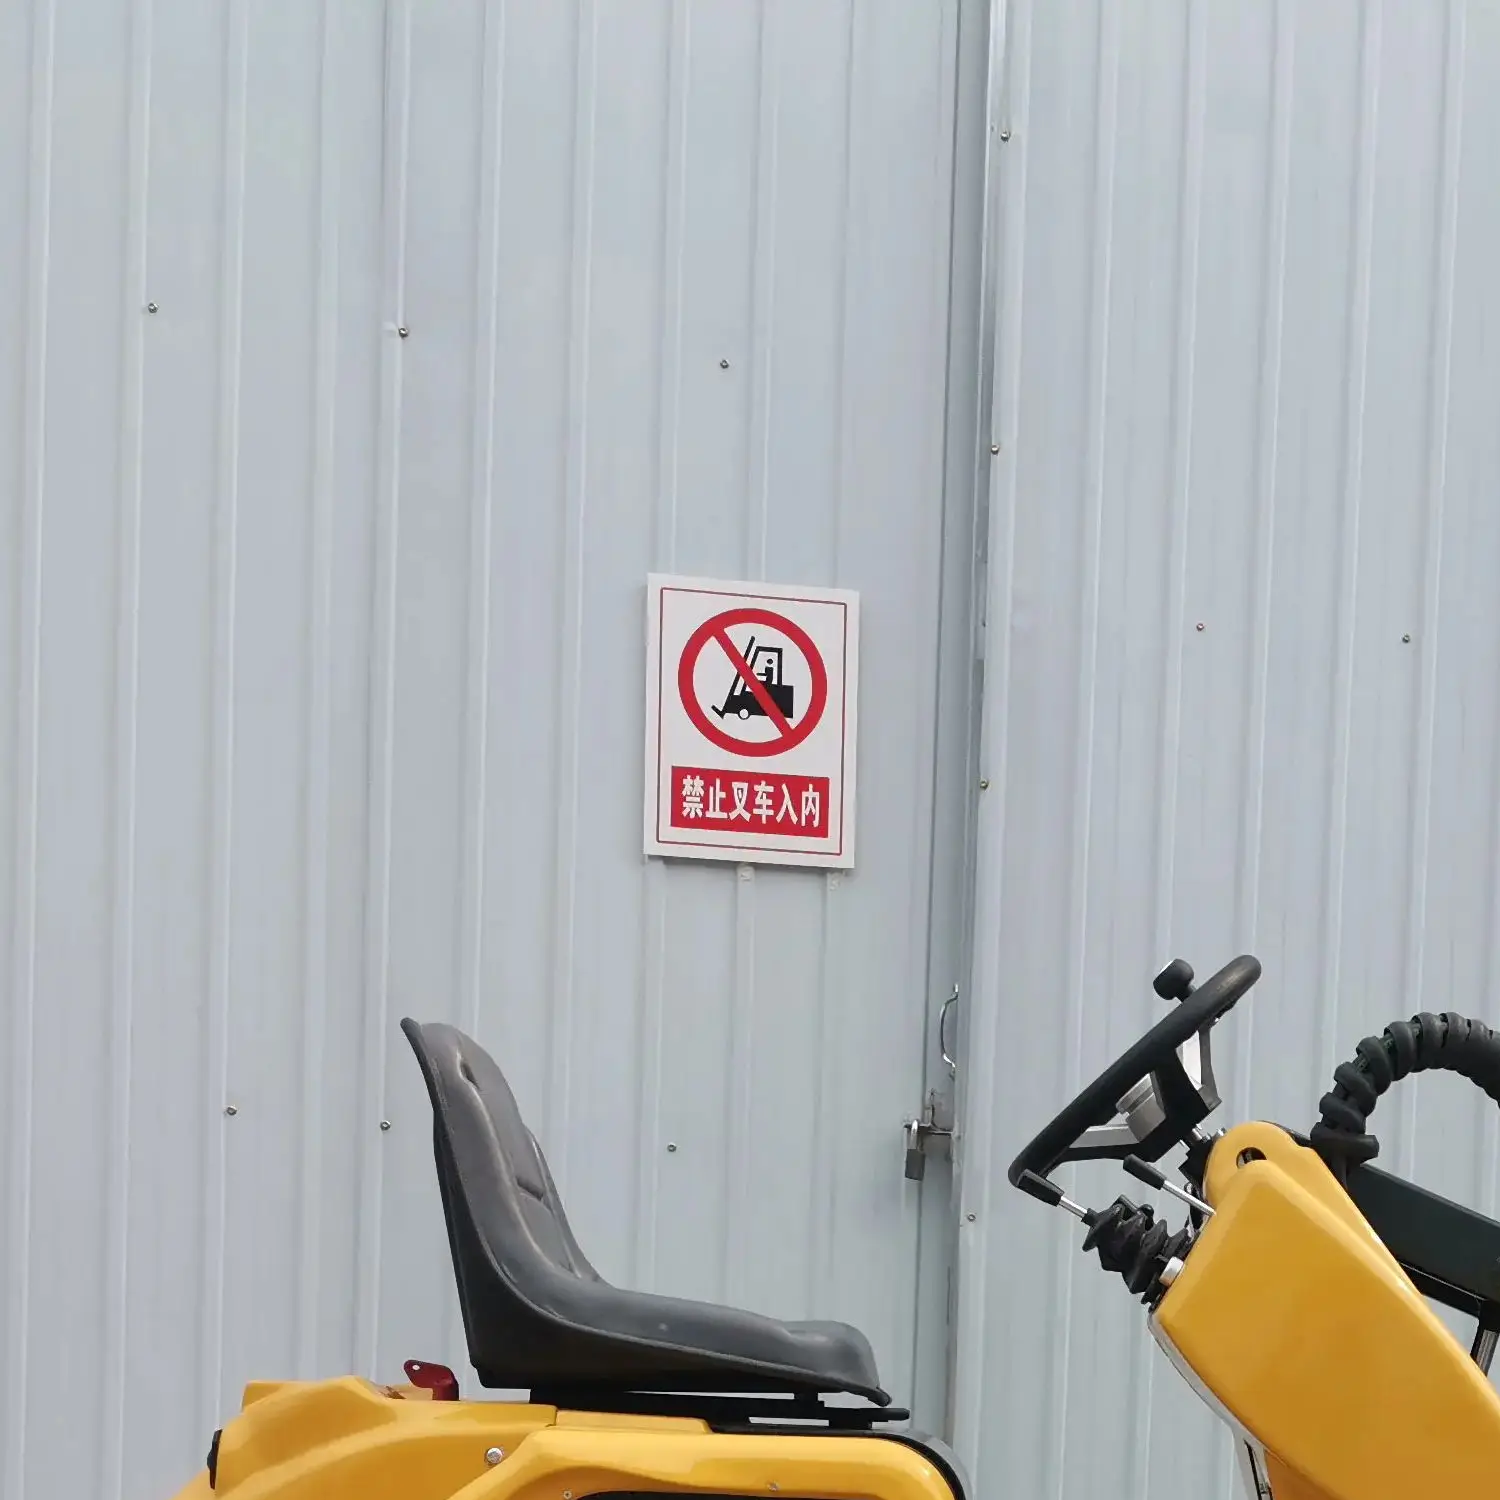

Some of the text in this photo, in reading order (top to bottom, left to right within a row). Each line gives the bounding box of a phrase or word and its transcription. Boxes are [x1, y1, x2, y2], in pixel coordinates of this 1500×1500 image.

[682, 775, 820, 827] 禁止叉车入内
